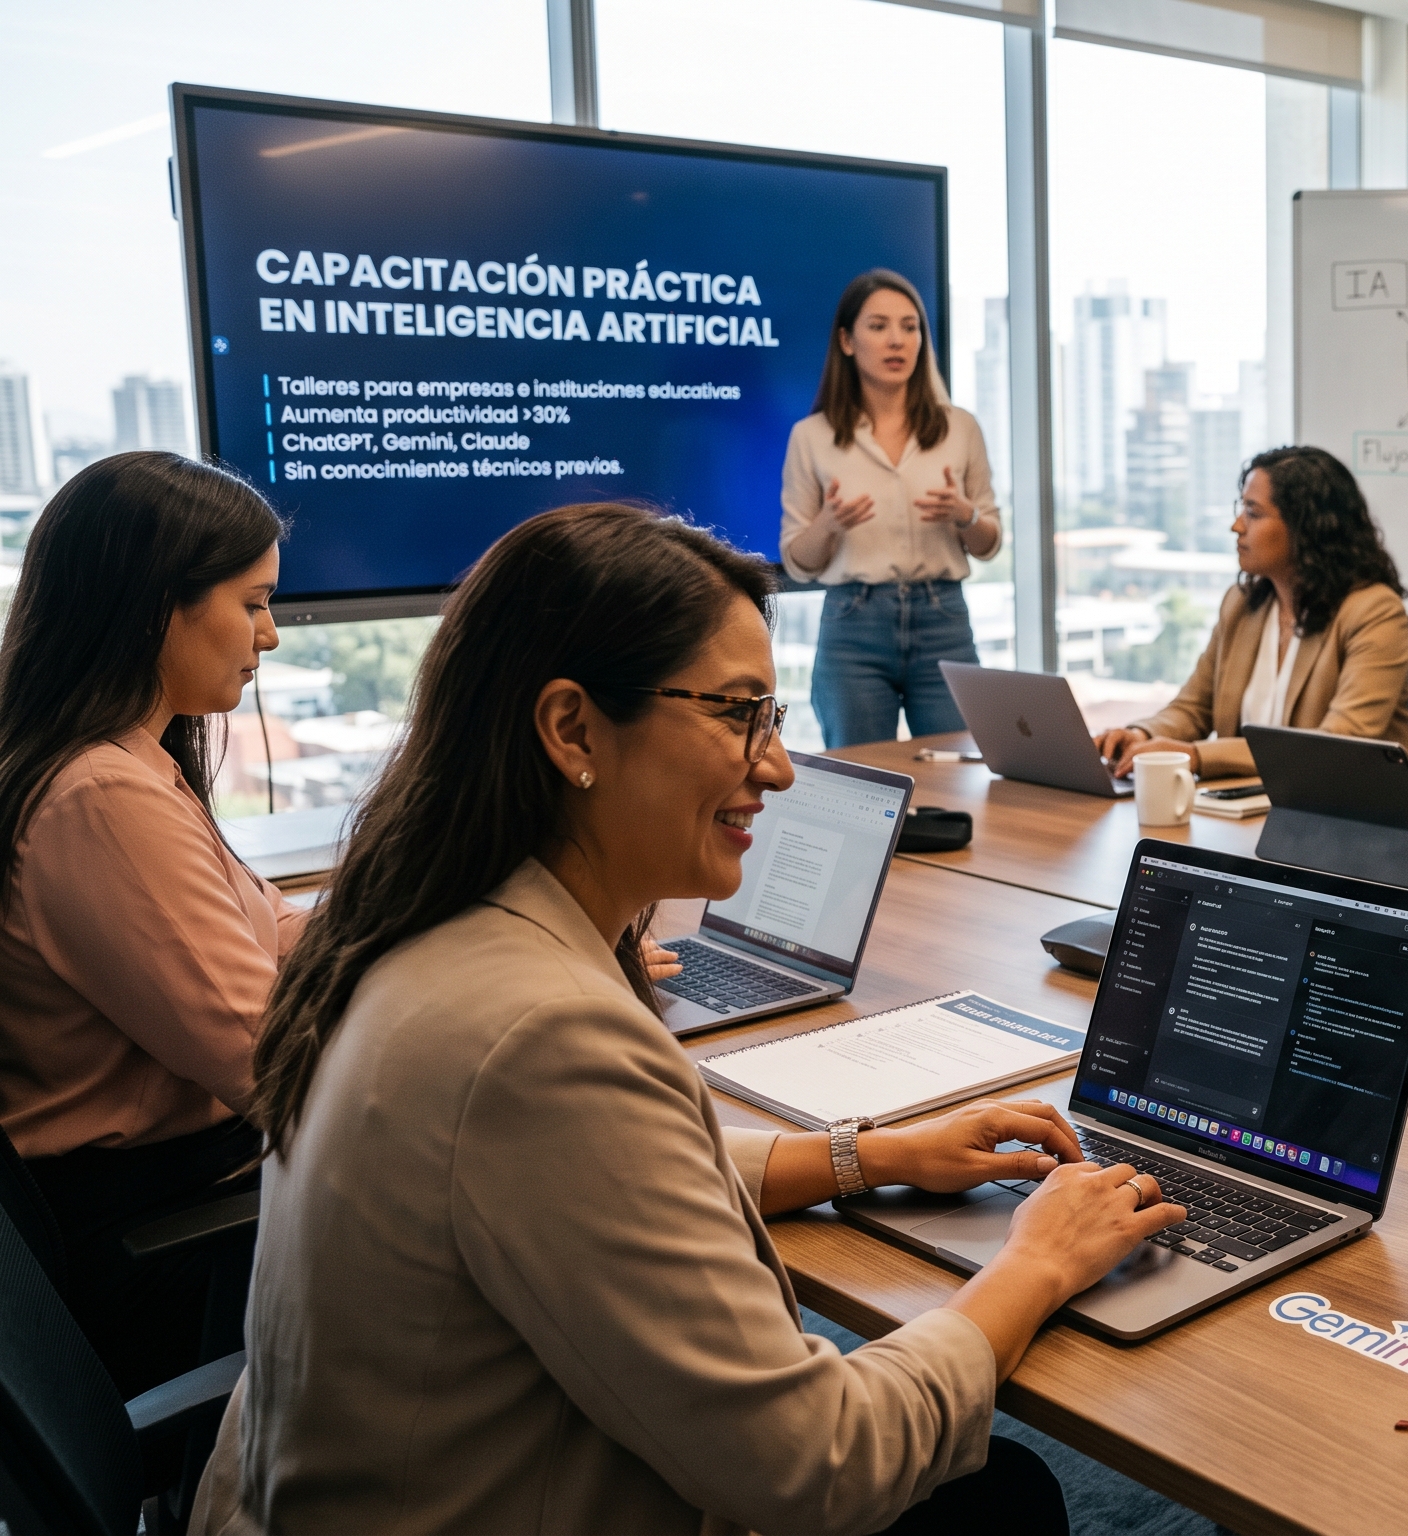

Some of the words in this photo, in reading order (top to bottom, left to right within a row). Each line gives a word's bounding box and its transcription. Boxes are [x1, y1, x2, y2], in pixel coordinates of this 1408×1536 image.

[256, 249, 575, 297] CAPACITACIÓN
[583, 260, 761, 305] PRÁCTICA
[1345, 270, 1390, 300] IA
[260, 298, 316, 332] EN
[325, 300, 590, 341] INTELIGENCIA
[597, 312, 779, 346] ARTIFICIAL
[278, 376, 360, 395] Talleres
[364, 381, 413, 401] para
[417, 382, 514, 401] empresas
[517, 383, 530, 397] e
[534, 379, 645, 398] instituciones
[648, 382, 740, 399] educativas
[281, 405, 378, 423] Aumenta
[383, 405, 518, 428] productividad
[523, 405, 570, 423] >30%
[283, 433, 378, 453] ChatGPT,
[382, 432, 458, 452] Gemini,
[461, 432, 530, 450] Claude
[285, 461, 316, 480] Sin
[321, 459, 469, 479] conocimientos
[473, 458, 552, 476] técnicos
[555, 456, 624, 479] previos.
